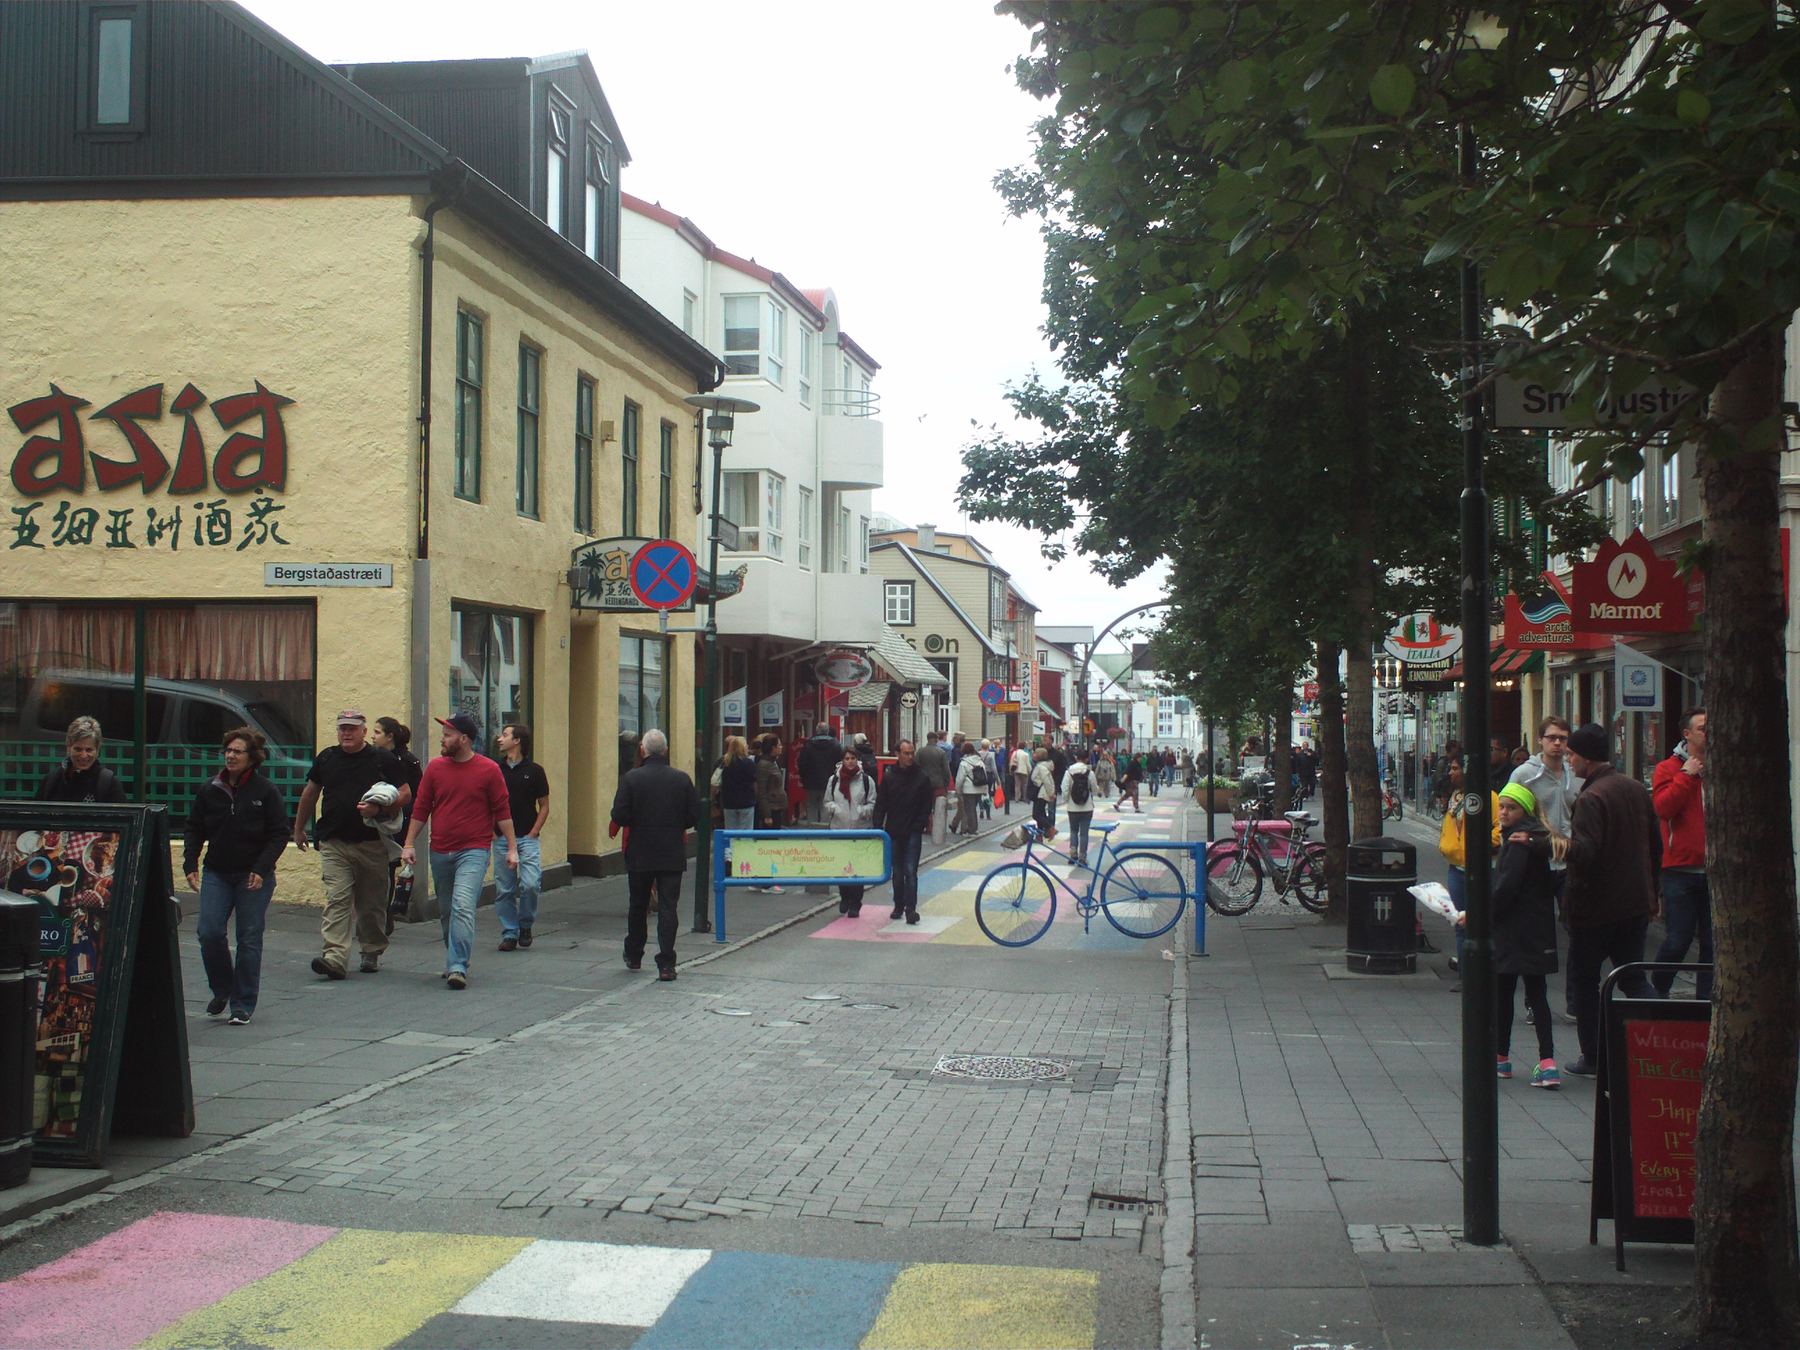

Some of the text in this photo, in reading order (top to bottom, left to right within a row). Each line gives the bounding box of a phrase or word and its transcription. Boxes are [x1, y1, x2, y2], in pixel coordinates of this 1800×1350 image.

[7, 380, 296, 495] asia
[273, 566, 383, 581] Bergstaðastræti
[1589, 602, 1662, 619] Marmot
[1545, 621, 1573, 632] arctic
[924, 633, 960, 654] On
[1519, 631, 1574, 644] adventures
[1406, 648, 1440, 660] ITALIA
[1633, 1026, 1707, 1050] WELCOM
